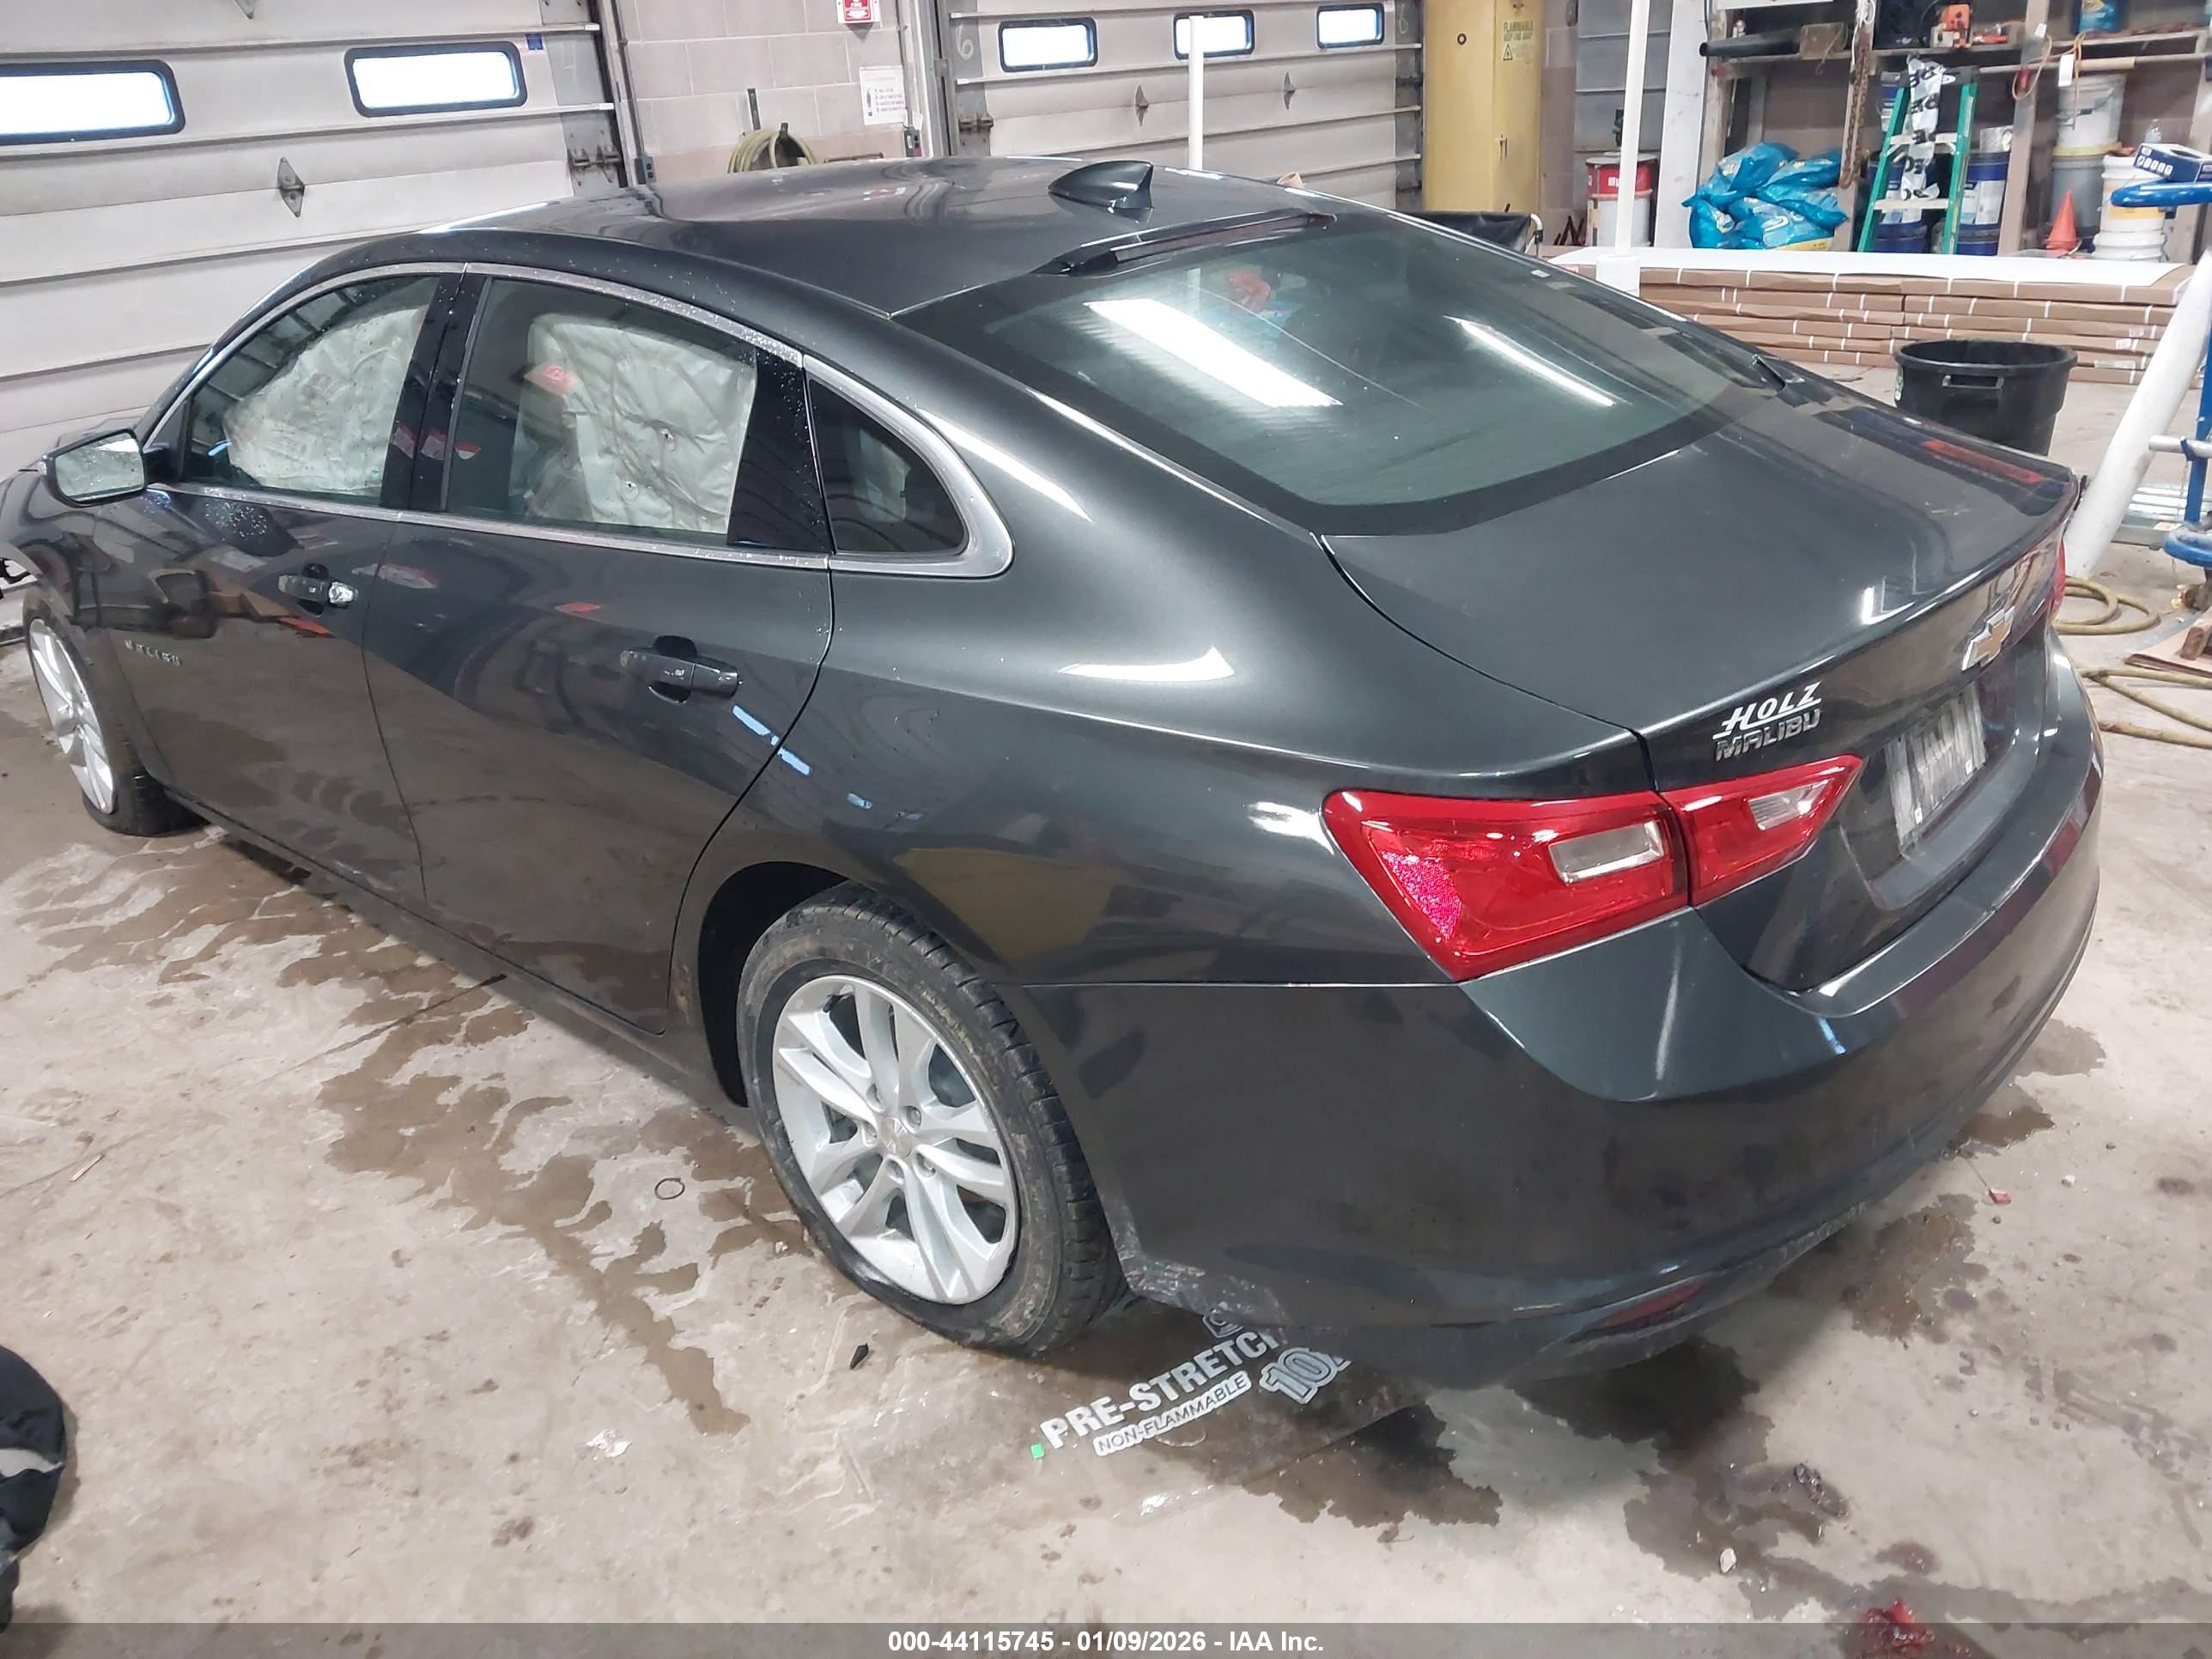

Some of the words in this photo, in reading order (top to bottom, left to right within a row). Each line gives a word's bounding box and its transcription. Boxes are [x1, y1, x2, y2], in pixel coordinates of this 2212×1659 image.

[1713, 680, 1822, 739] HOLZ
[1716, 708, 1820, 763] MALIBU
[1096, 1373, 1250, 1455] NON-FLAMMABLE
